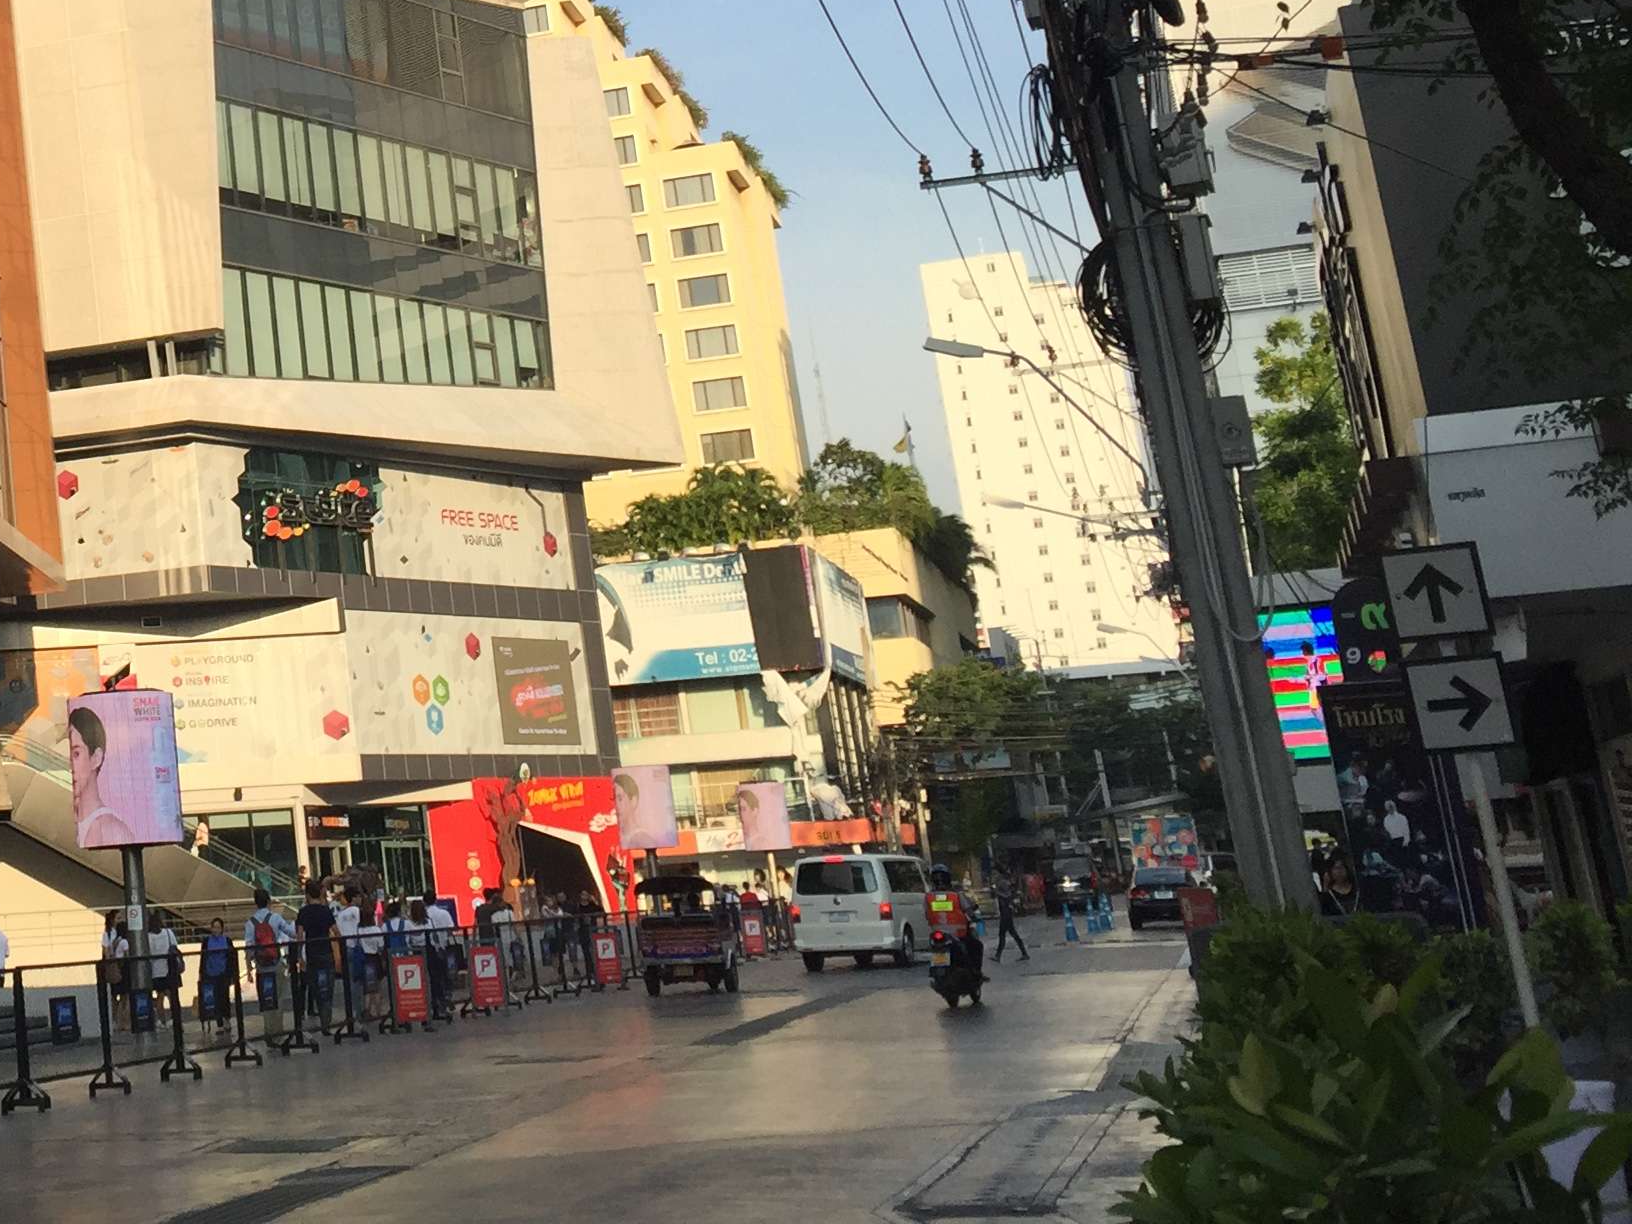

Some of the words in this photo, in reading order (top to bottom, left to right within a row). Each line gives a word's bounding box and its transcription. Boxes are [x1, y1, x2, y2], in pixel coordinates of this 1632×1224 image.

[441, 508, 475, 528] FREE
[478, 512, 519, 532] SPACE
[654, 563, 701, 583] SMILE
[695, 651, 719, 666] Tel
